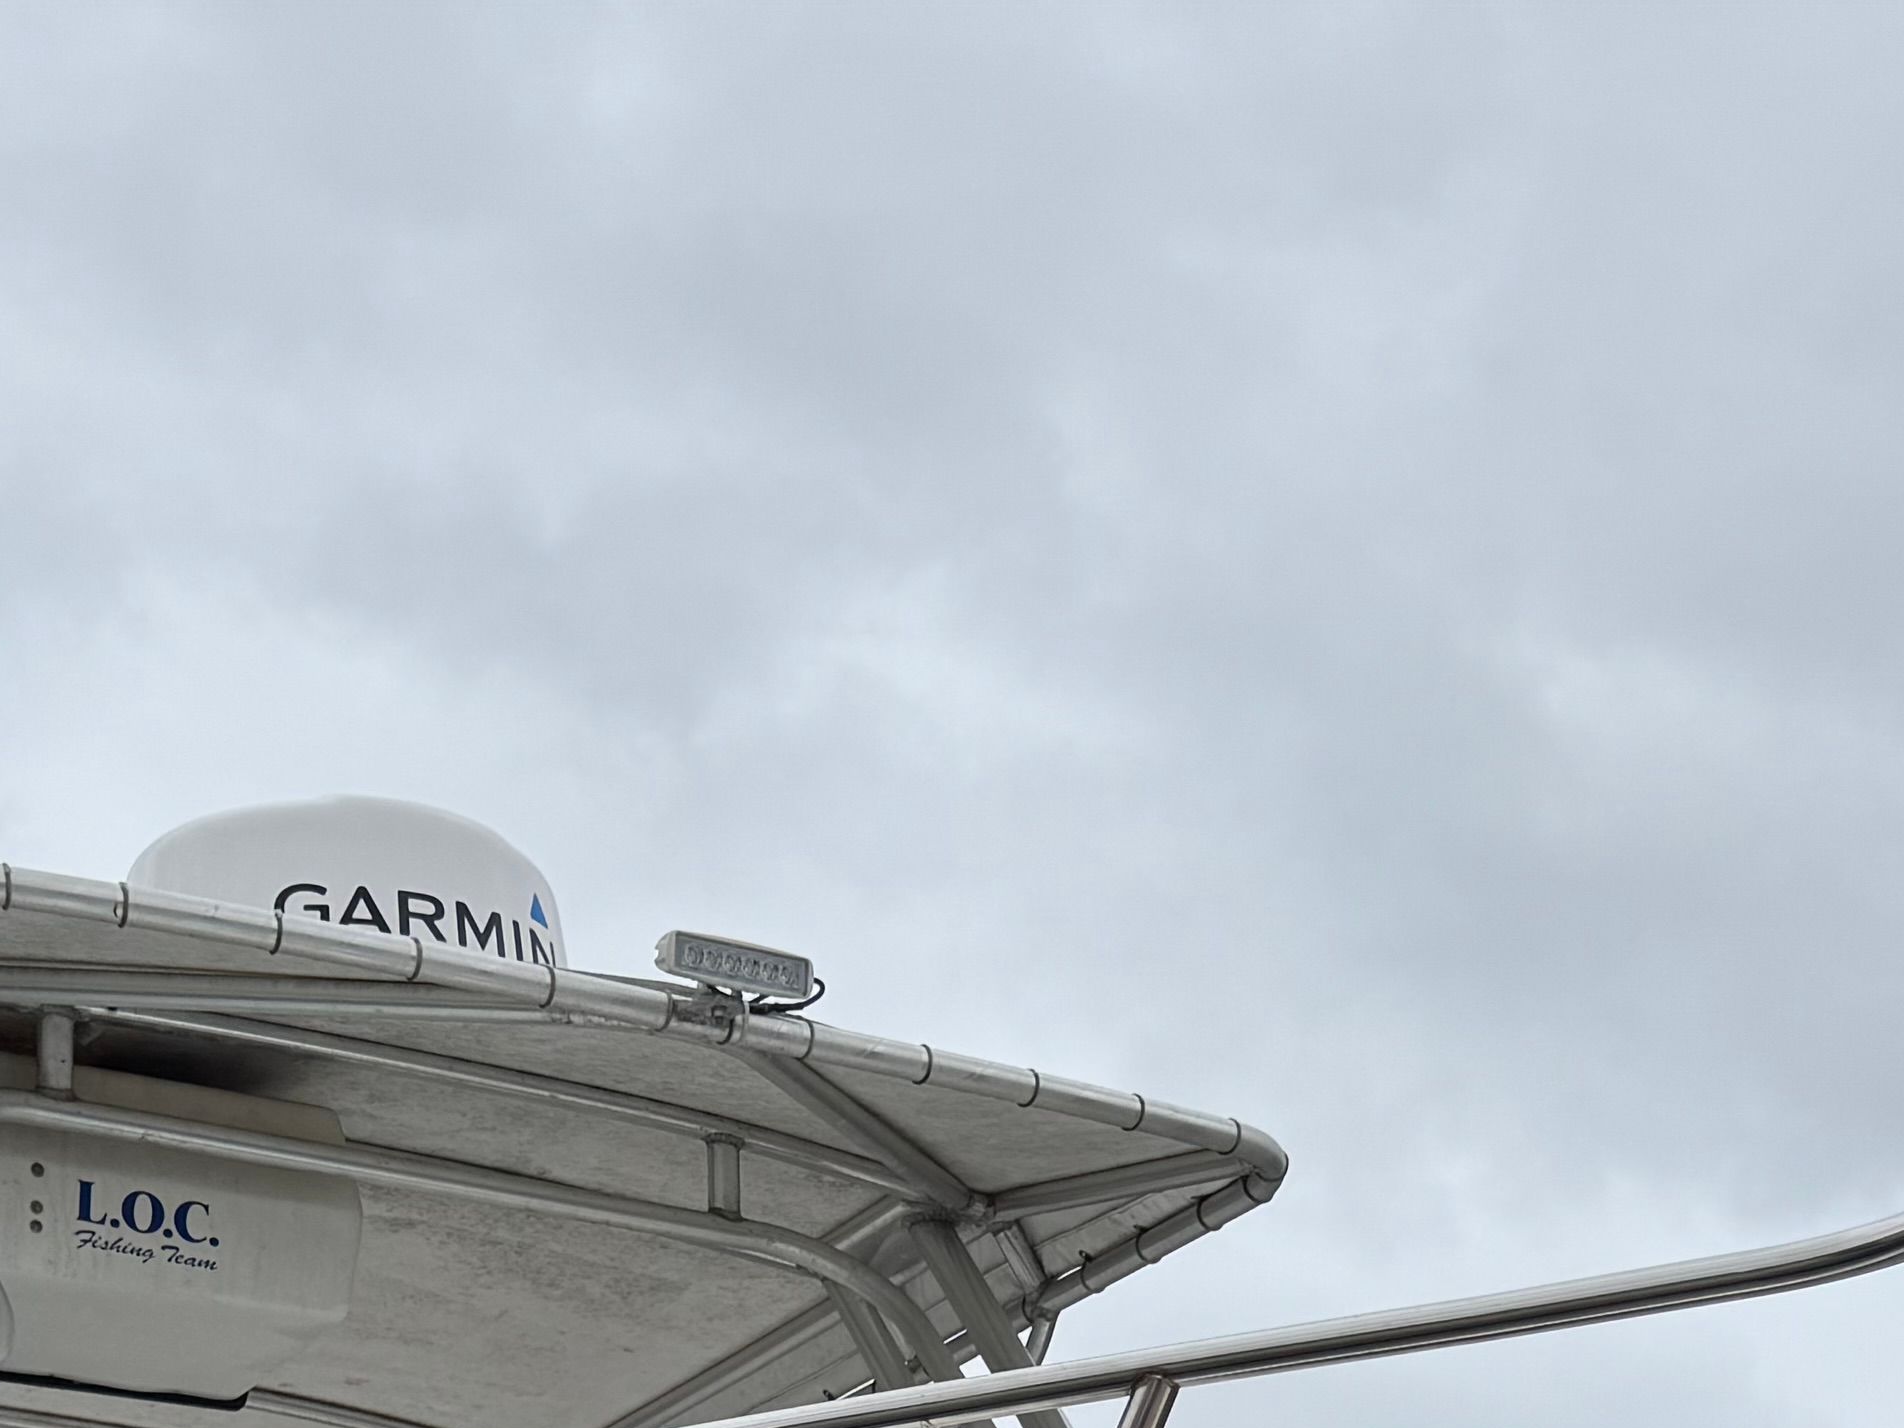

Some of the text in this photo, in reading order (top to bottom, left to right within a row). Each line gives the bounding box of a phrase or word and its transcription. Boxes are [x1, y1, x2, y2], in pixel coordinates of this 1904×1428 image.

[274, 883, 556, 968] GARMIN
[76, 1179, 220, 1247] L.O.C.
[74, 1229, 218, 1271] Fishing Team
